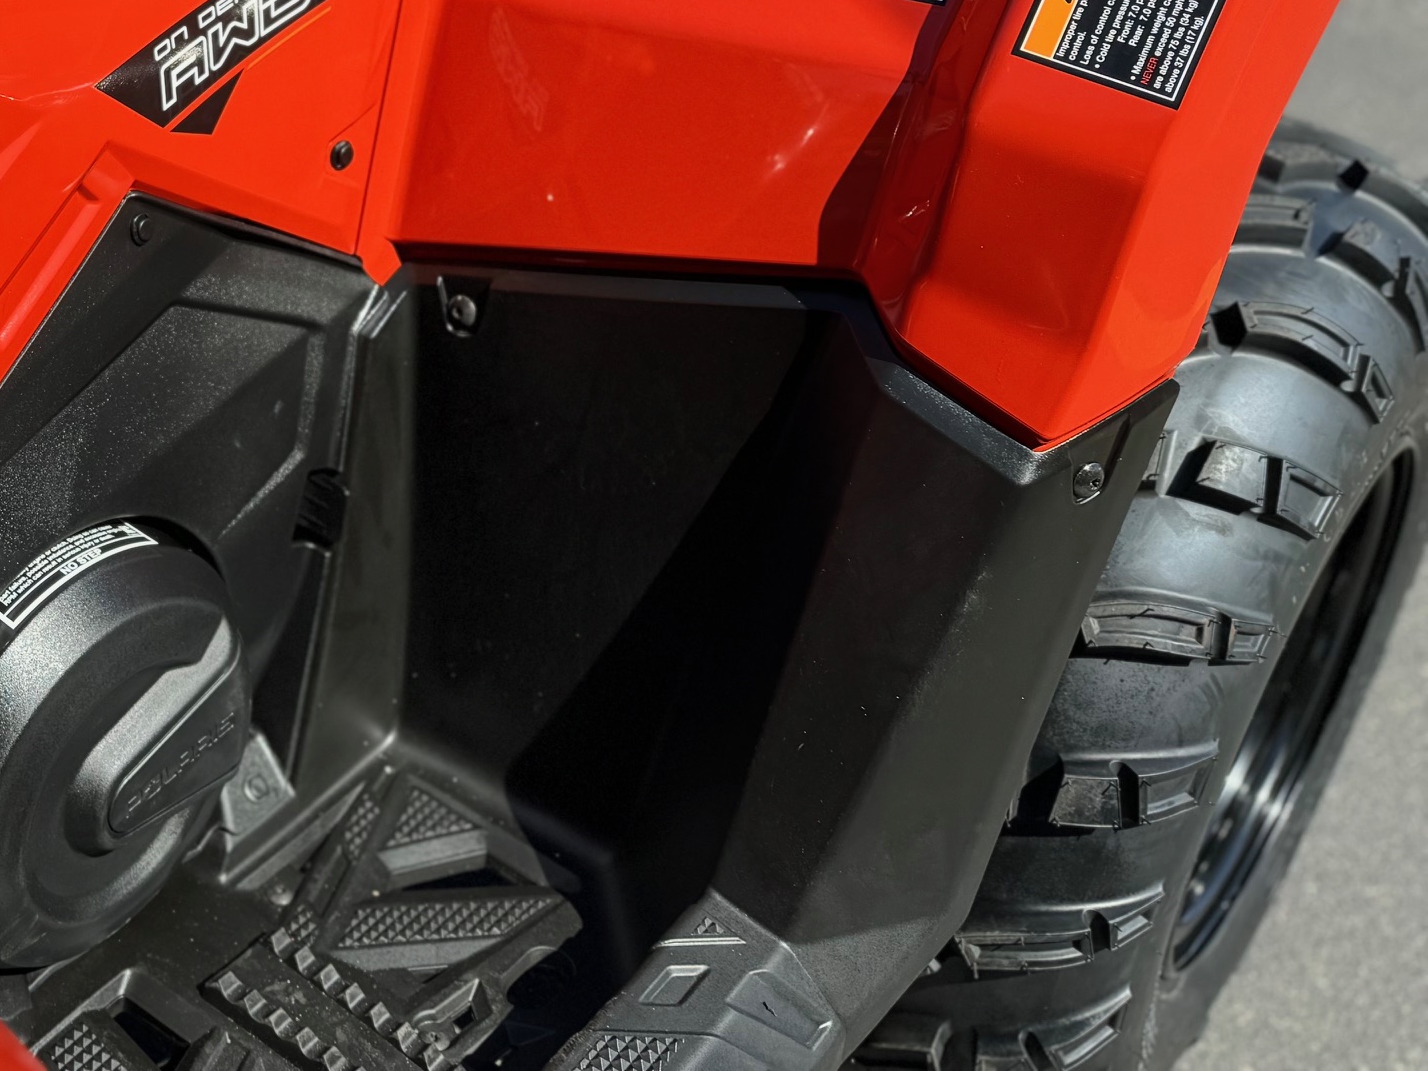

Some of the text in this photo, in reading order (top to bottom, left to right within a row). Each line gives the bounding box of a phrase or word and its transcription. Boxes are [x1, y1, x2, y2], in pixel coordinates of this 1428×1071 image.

[1094, 6, 1112, 35] control
[1179, 13, 1191, 26] (34
[1185, 0, 1199, 13] kg)
[1056, 21, 1078, 57] Improper
[1072, 7, 1085, 20] tire
[1117, 19, 1134, 43] Front:
[1128, 5, 1140, 18] 7.0
[1128, 25, 1145, 47] Rear:
[1139, 8, 1152, 21] 7.0
[1173, 27, 1186, 39] lbs
[1069, 31, 1087, 61] control.
[1090, 34, 1099, 45] of
[1096, 42, 1111, 63] Cold
[1104, 29, 1117, 43] tire
[1131, 35, 1155, 75] Maximum
[1150, 7, 1168, 34] weight
[1140, 57, 1158, 85] NEVER
[1154, 27, 1172, 57] exceed
[1165, 16, 1177, 28] 50
[1168, 39, 1180, 50] 75
[1079, 45, 1095, 65] Loss
[1159, 51, 1175, 75] above
[1165, 16, 1204, 93] above 37 lbs (17 kg).
[1153, 76, 1164, 89] are
[59, 548, 102, 575] NO STEP
